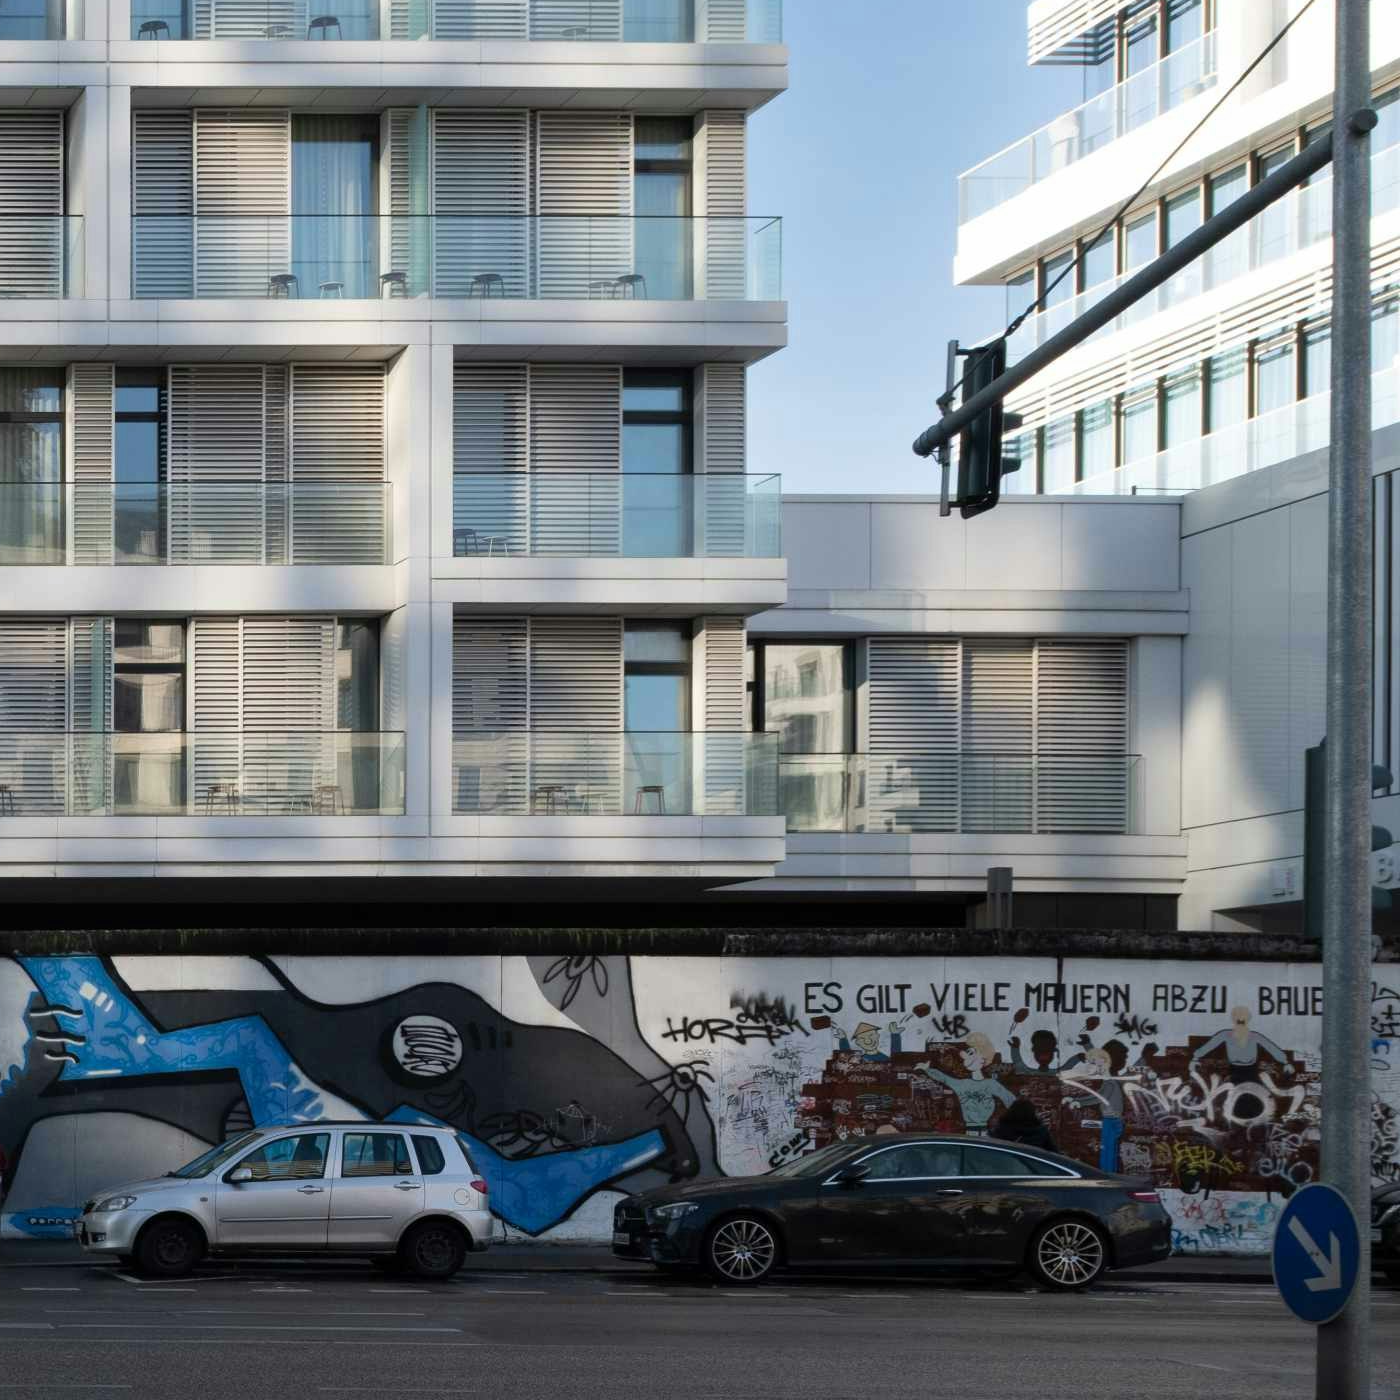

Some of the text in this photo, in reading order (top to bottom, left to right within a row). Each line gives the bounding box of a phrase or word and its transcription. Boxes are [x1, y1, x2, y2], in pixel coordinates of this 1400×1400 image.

[804, 981, 844, 1014] ES
[856, 984, 912, 1013] GILT
[930, 982, 1011, 1012] VIELE
[1024, 982, 1130, 1014] MAUERN
[1258, 986, 1325, 1016] BAUE
